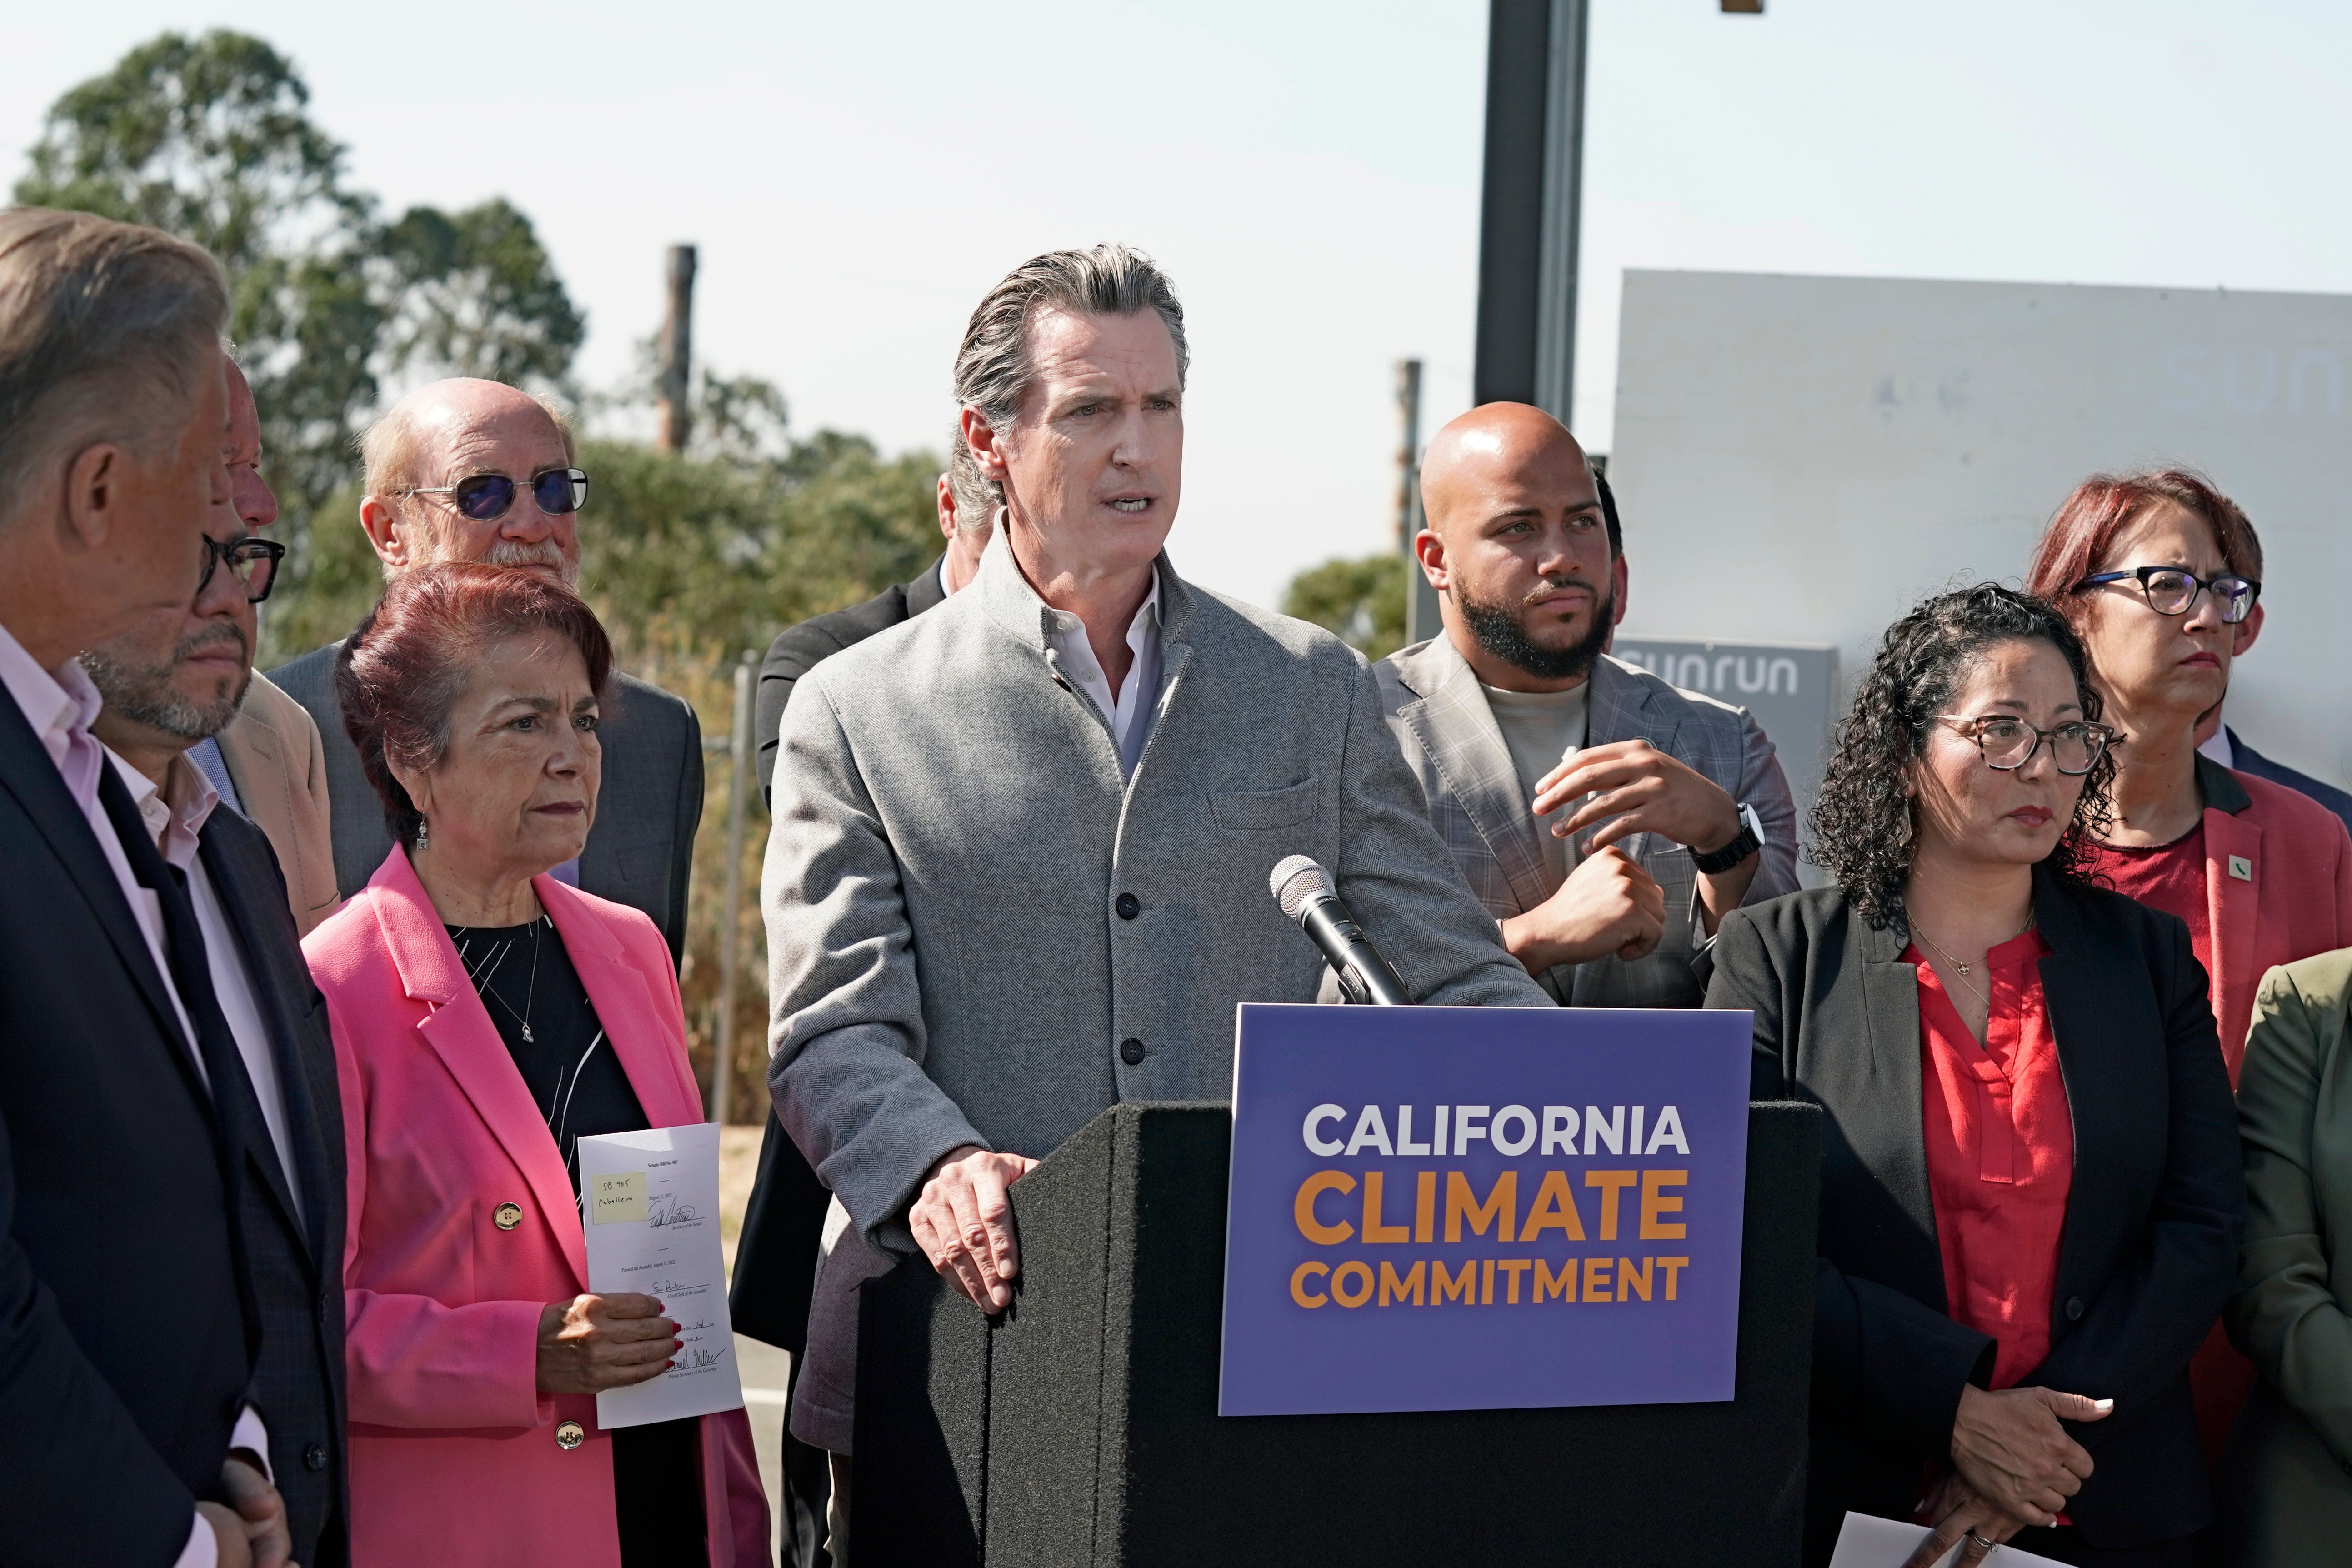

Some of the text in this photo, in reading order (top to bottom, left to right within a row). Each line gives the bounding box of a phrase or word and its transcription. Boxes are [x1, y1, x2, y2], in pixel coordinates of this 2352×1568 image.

[1302, 1103, 1690, 1156] CALIFORNIA
[603, 1178, 630, 1191] SB 905
[1295, 1169, 1688, 1245] CLIMATE
[1290, 1256, 1689, 1308] COMMITMENT
